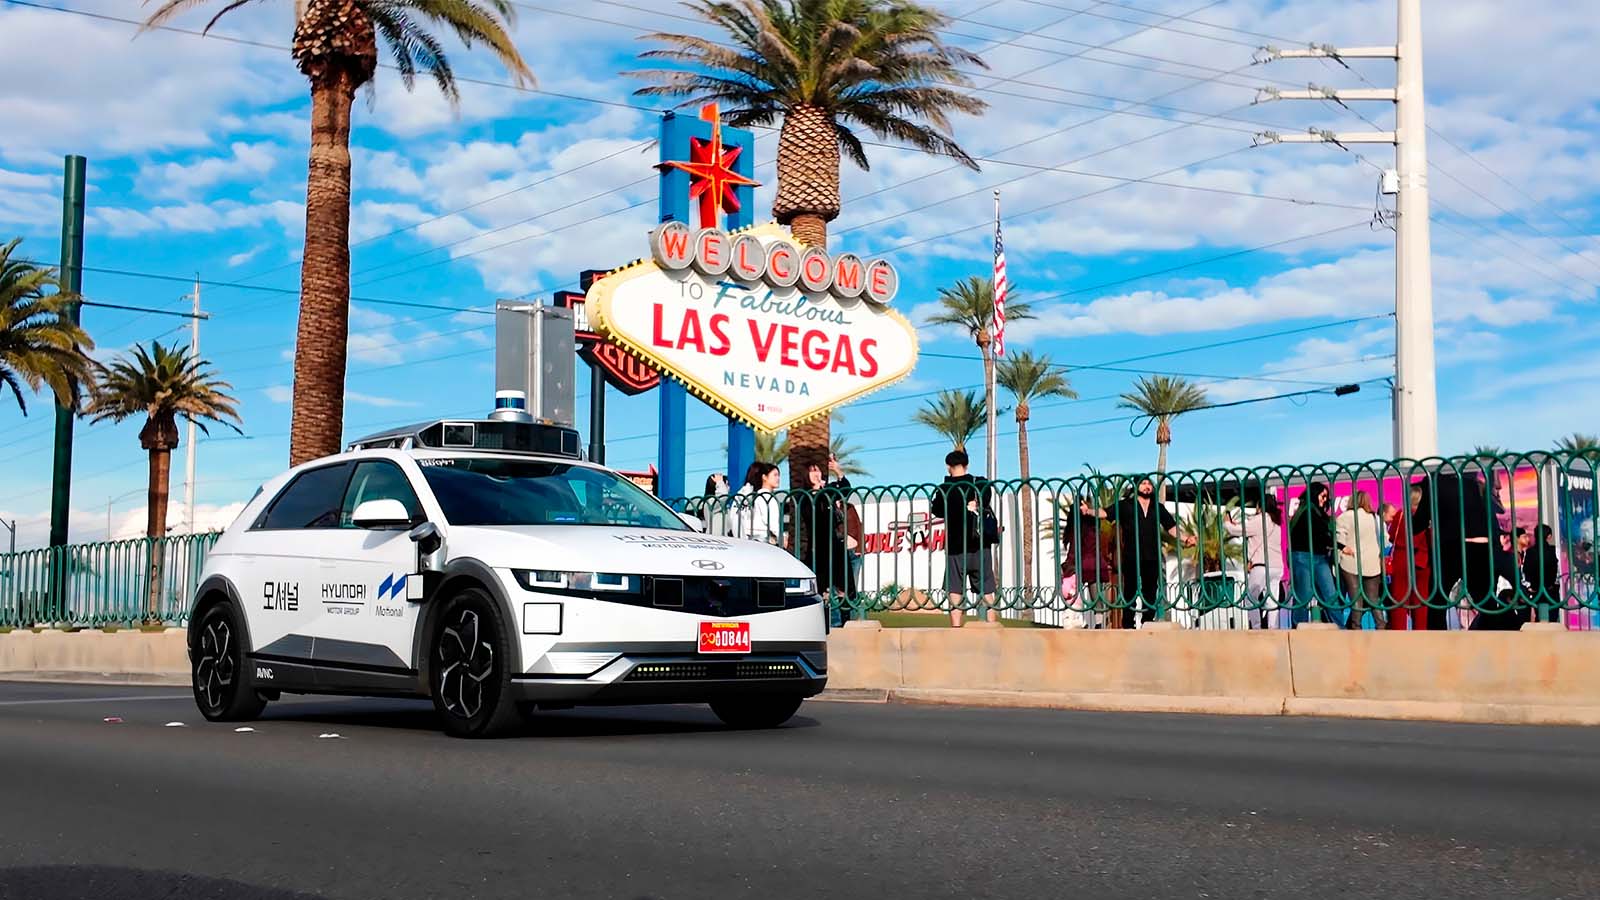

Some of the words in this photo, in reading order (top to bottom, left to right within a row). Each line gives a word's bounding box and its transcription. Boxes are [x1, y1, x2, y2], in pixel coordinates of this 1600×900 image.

[664, 232, 890, 296] WELCOME
[680, 279, 704, 300] TO
[713, 280, 852, 325] Fabulous
[652, 302, 731, 357] LAS
[747, 318, 879, 378] VEGAS
[723, 370, 810, 397] NEVADA
[612, 533, 729, 545] HYUNDAI
[263, 581, 299, 611] 모셔널
[321, 583, 367, 599] HYUNDAI
[375, 605, 404, 617] Motional
